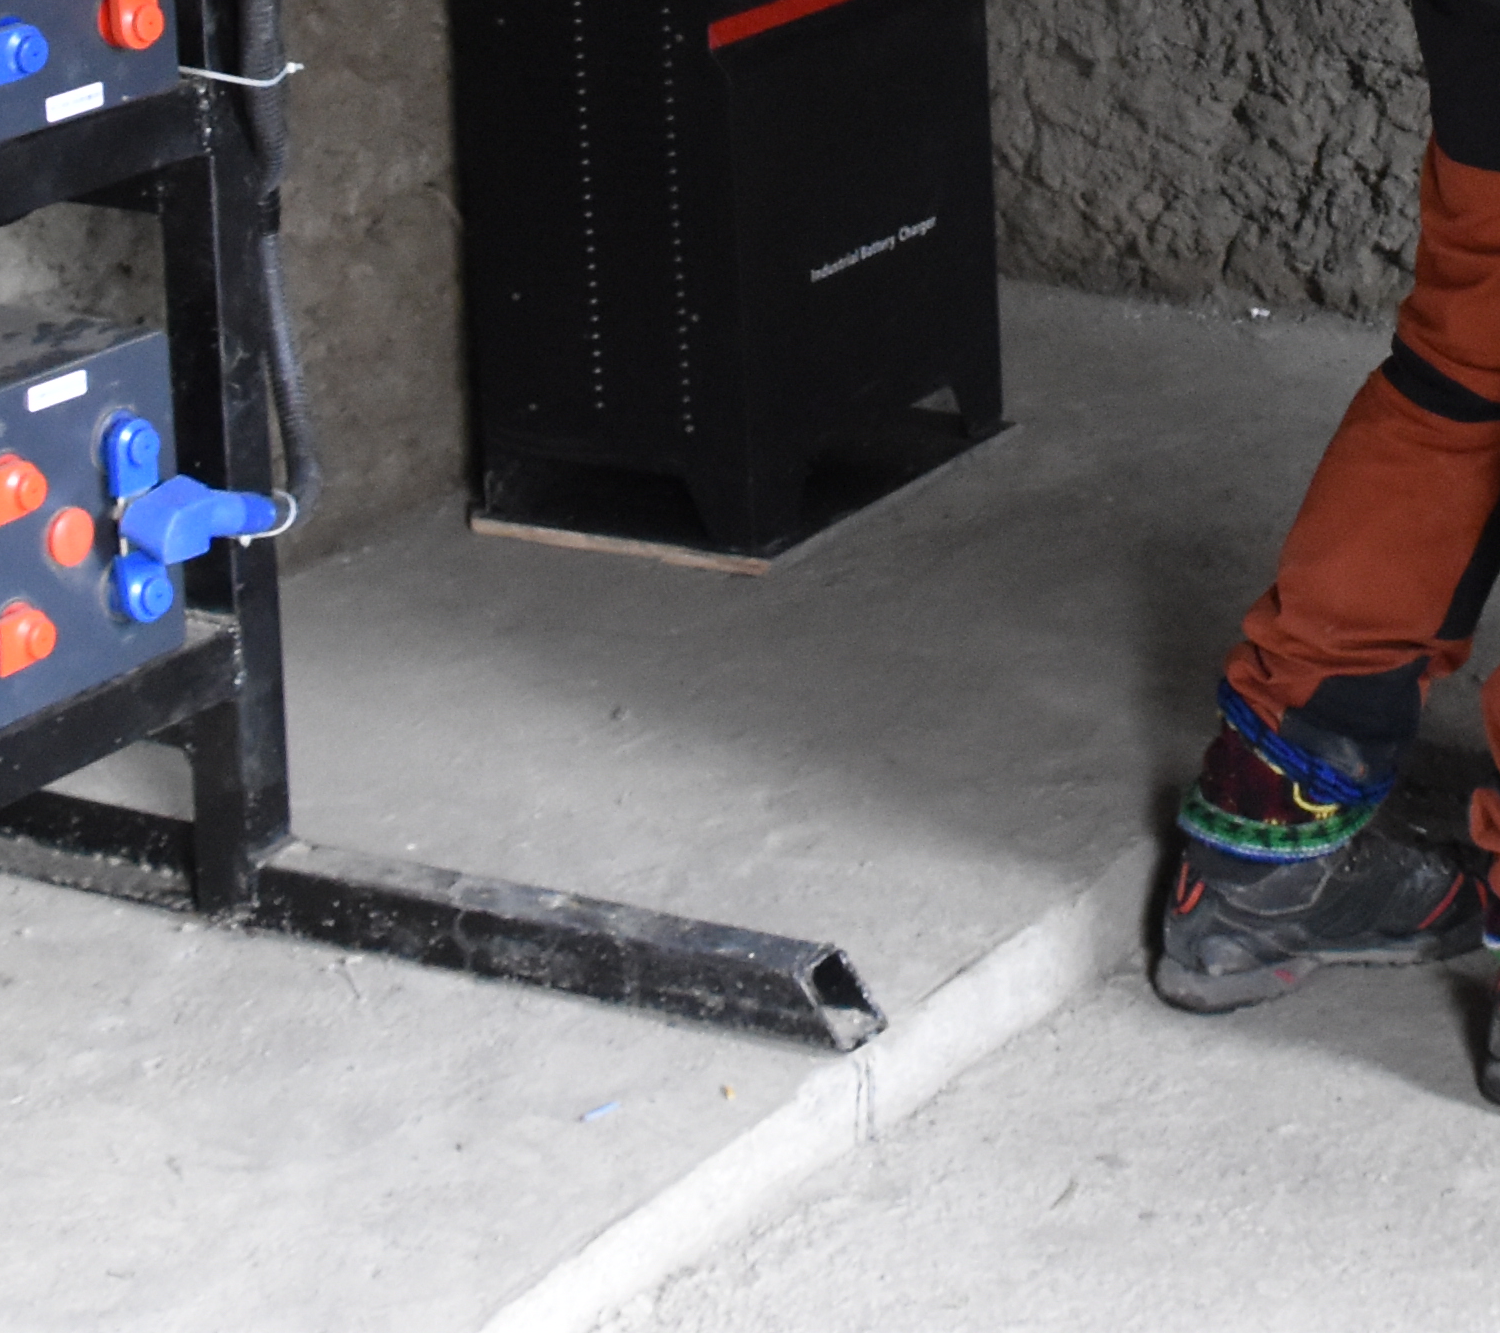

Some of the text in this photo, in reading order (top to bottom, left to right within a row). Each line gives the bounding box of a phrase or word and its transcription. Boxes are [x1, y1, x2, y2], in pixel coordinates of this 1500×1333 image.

[810, 216, 937, 283] Industrial Battery Charger
